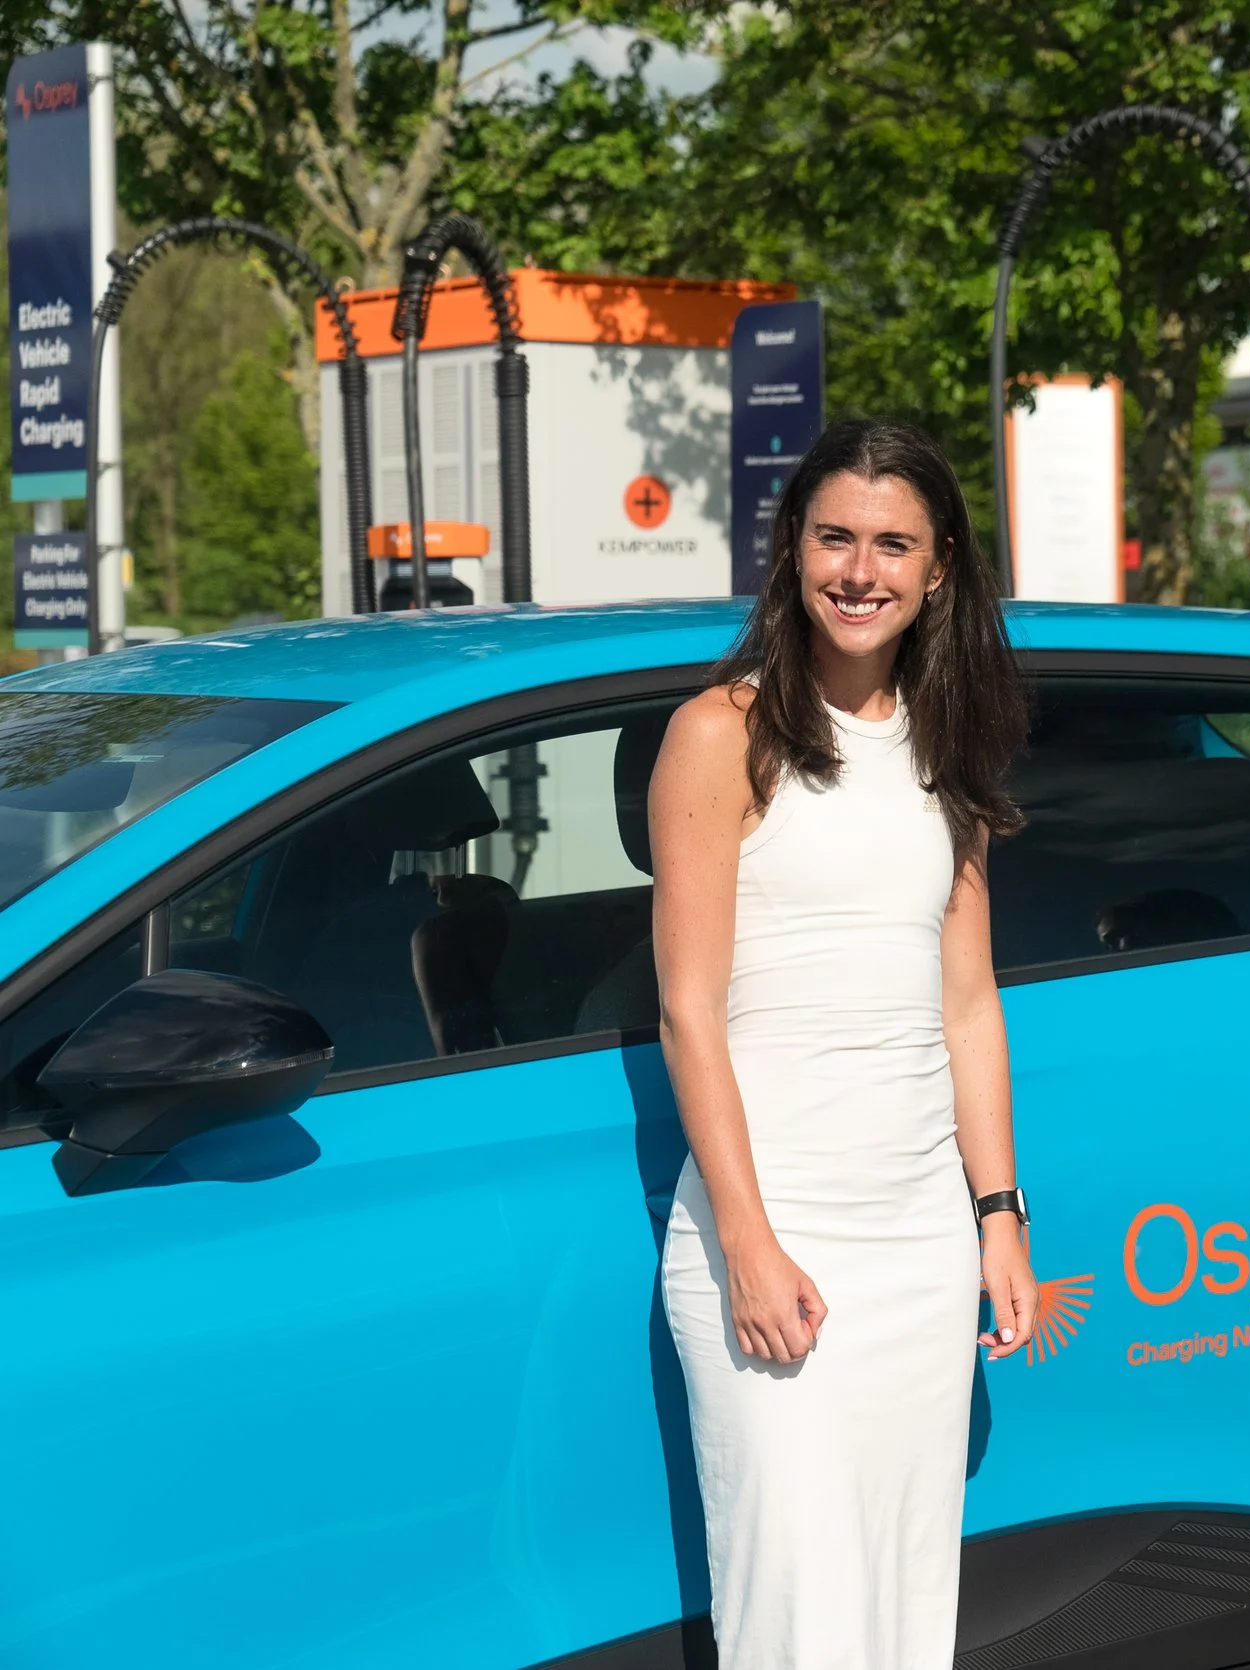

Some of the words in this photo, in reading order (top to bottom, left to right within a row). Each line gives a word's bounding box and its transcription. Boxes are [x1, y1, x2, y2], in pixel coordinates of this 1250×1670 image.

[18, 298, 72, 331] Electric
[18, 336, 71, 369] Vehicle
[19, 375, 60, 412] Rapid
[20, 414, 85, 449] Charging
[1127, 1332, 1228, 1366] Charging
